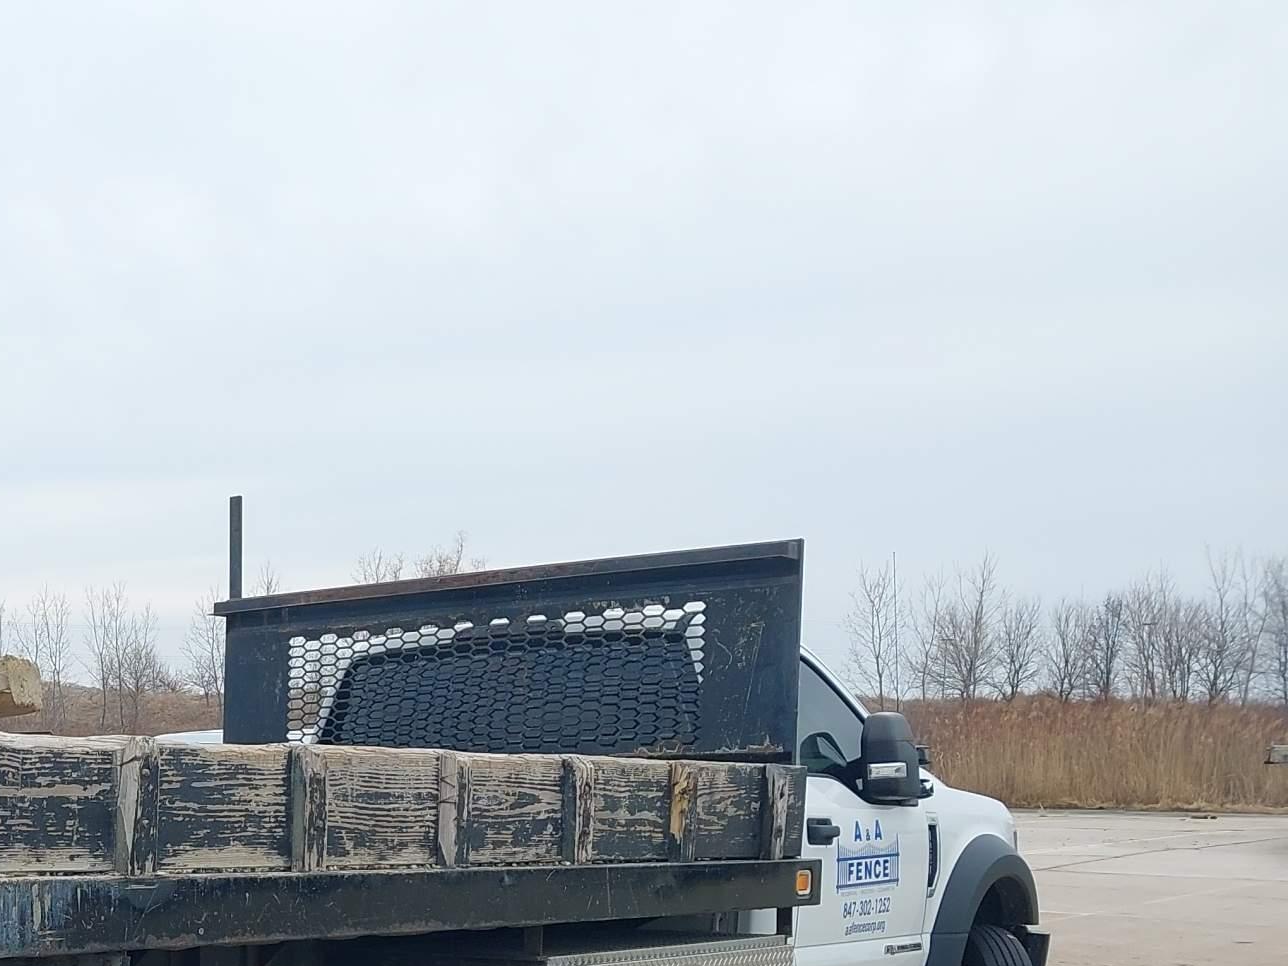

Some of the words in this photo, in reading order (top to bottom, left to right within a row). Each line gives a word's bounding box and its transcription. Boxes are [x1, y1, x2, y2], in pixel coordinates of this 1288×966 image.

[854, 820, 863, 842] A
[865, 828, 871, 841] &
[874, 819, 883, 841] A
[848, 859, 889, 881] FENCE
[843, 897, 890, 918] 847-302-1252
